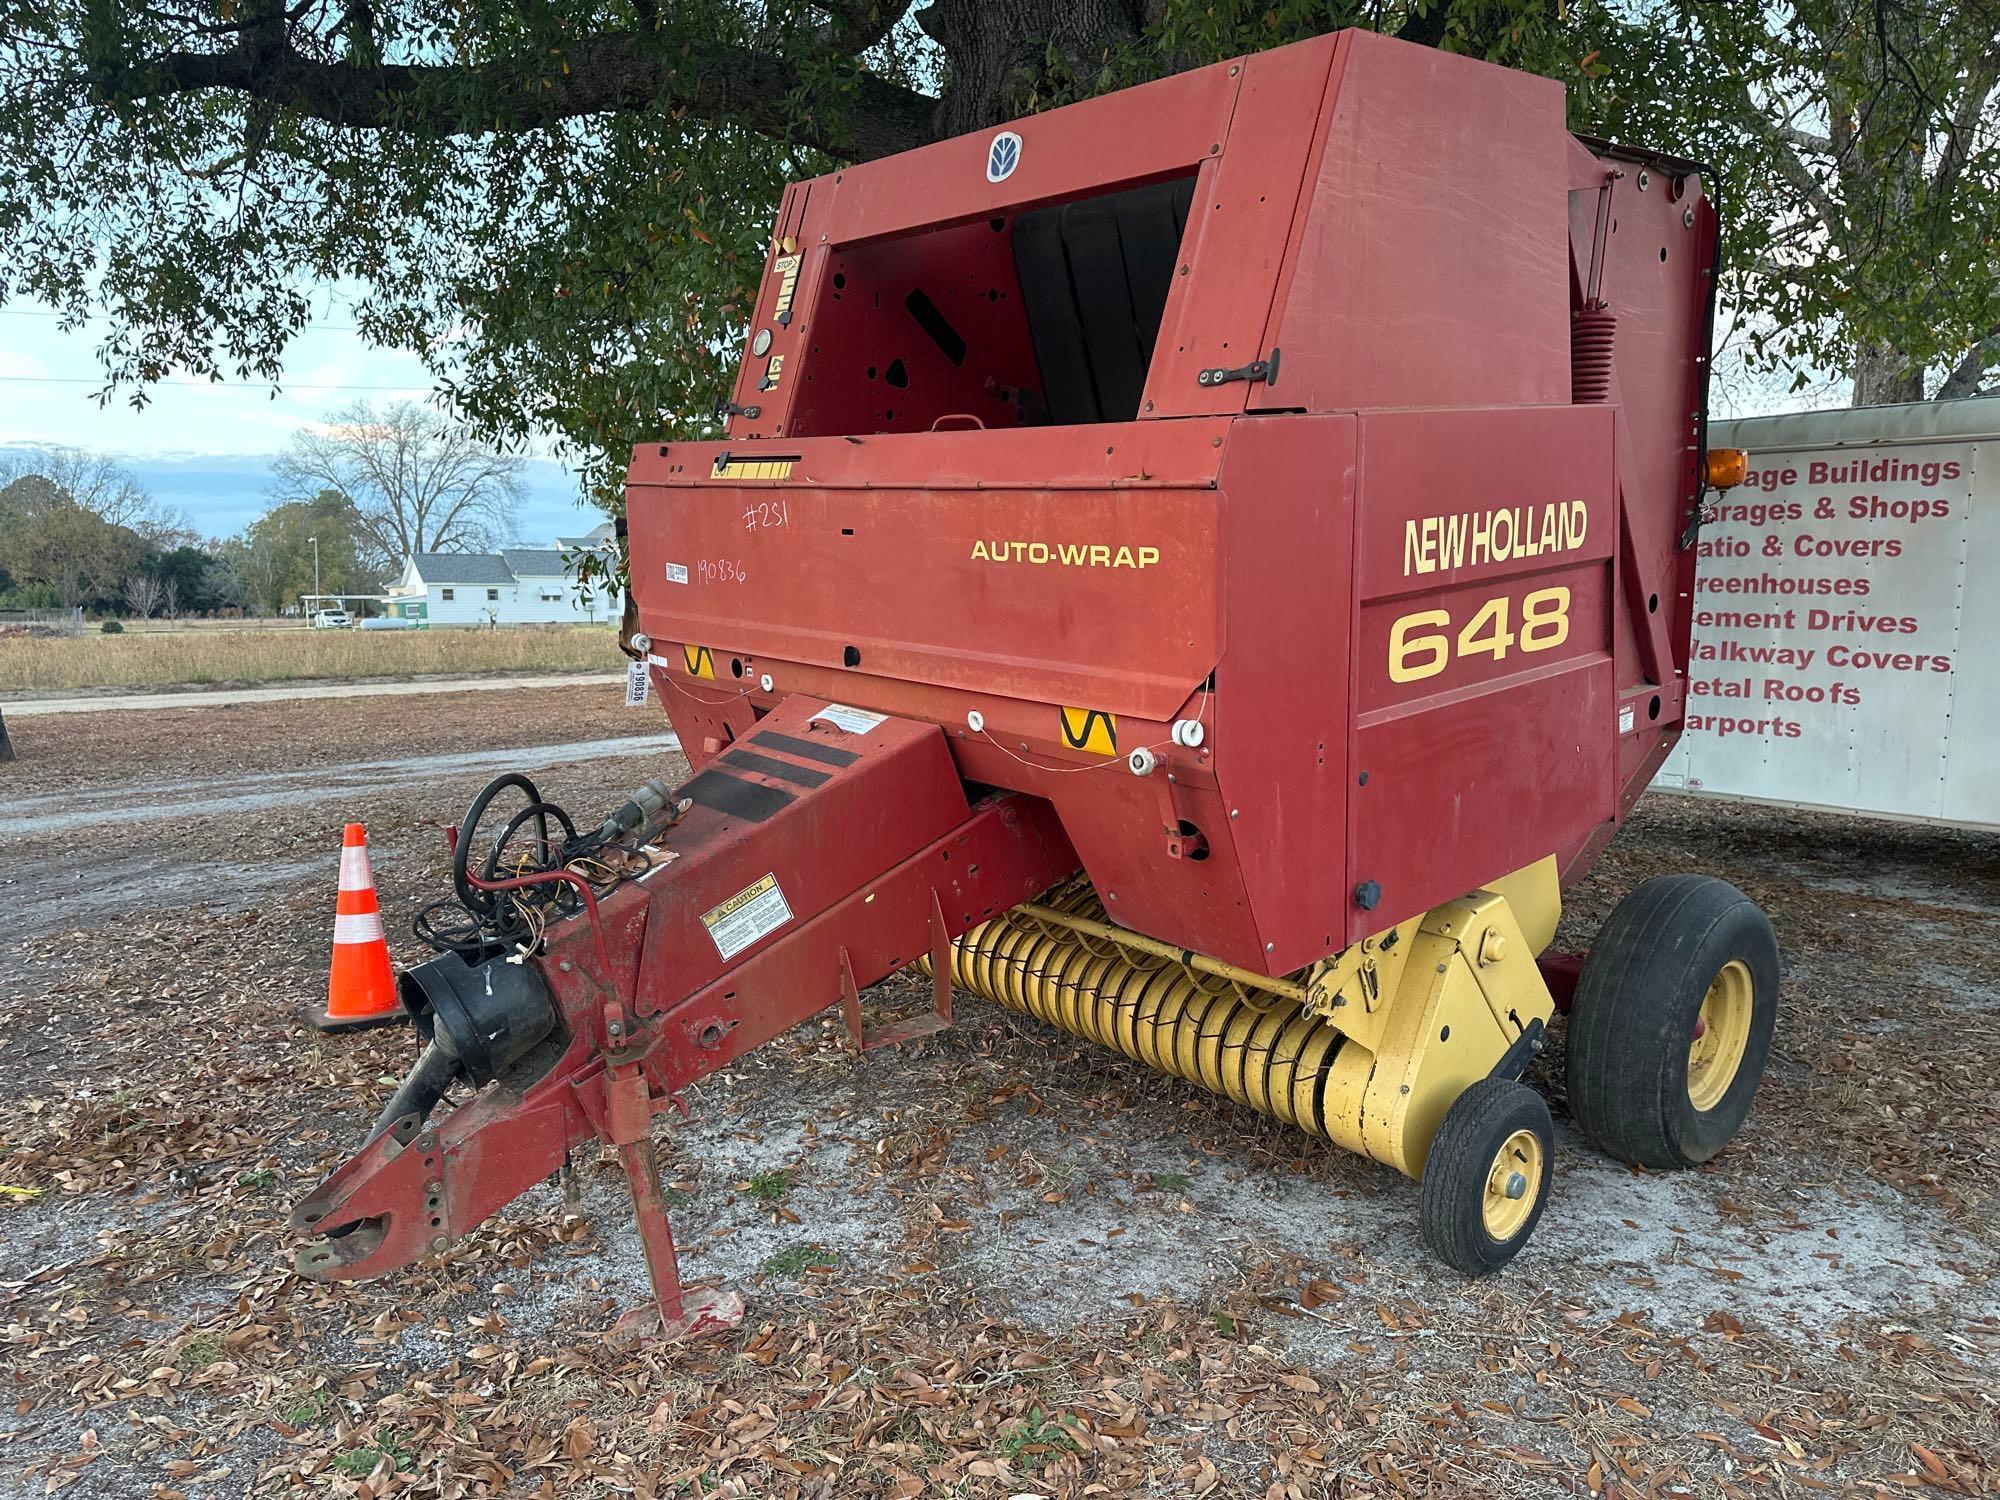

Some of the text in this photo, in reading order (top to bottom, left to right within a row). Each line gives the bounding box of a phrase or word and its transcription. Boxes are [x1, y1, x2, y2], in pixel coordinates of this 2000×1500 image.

[776, 260, 793, 270] STOP
[1743, 458, 1961, 492] age Buildings
[1703, 495, 1950, 527] arages & Shops
[1403, 500, 1587, 576] NEW HOLLAND
[1697, 534, 1902, 558] atio & Covers
[970, 540, 1160, 569] AUTO-WRAP
[697, 559, 746, 585] 190836
[1696, 573, 1870, 596] reenhouses
[1388, 586, 1571, 684] 648
[1696, 609, 1918, 634] ement Drives
[1826, 645, 1951, 673] Covers
[633, 671, 646, 701] 190836
[1763, 679, 1861, 705] Roofs
[1686, 715, 1802, 738] arports
[725, 884, 763, 912] CAUTION
